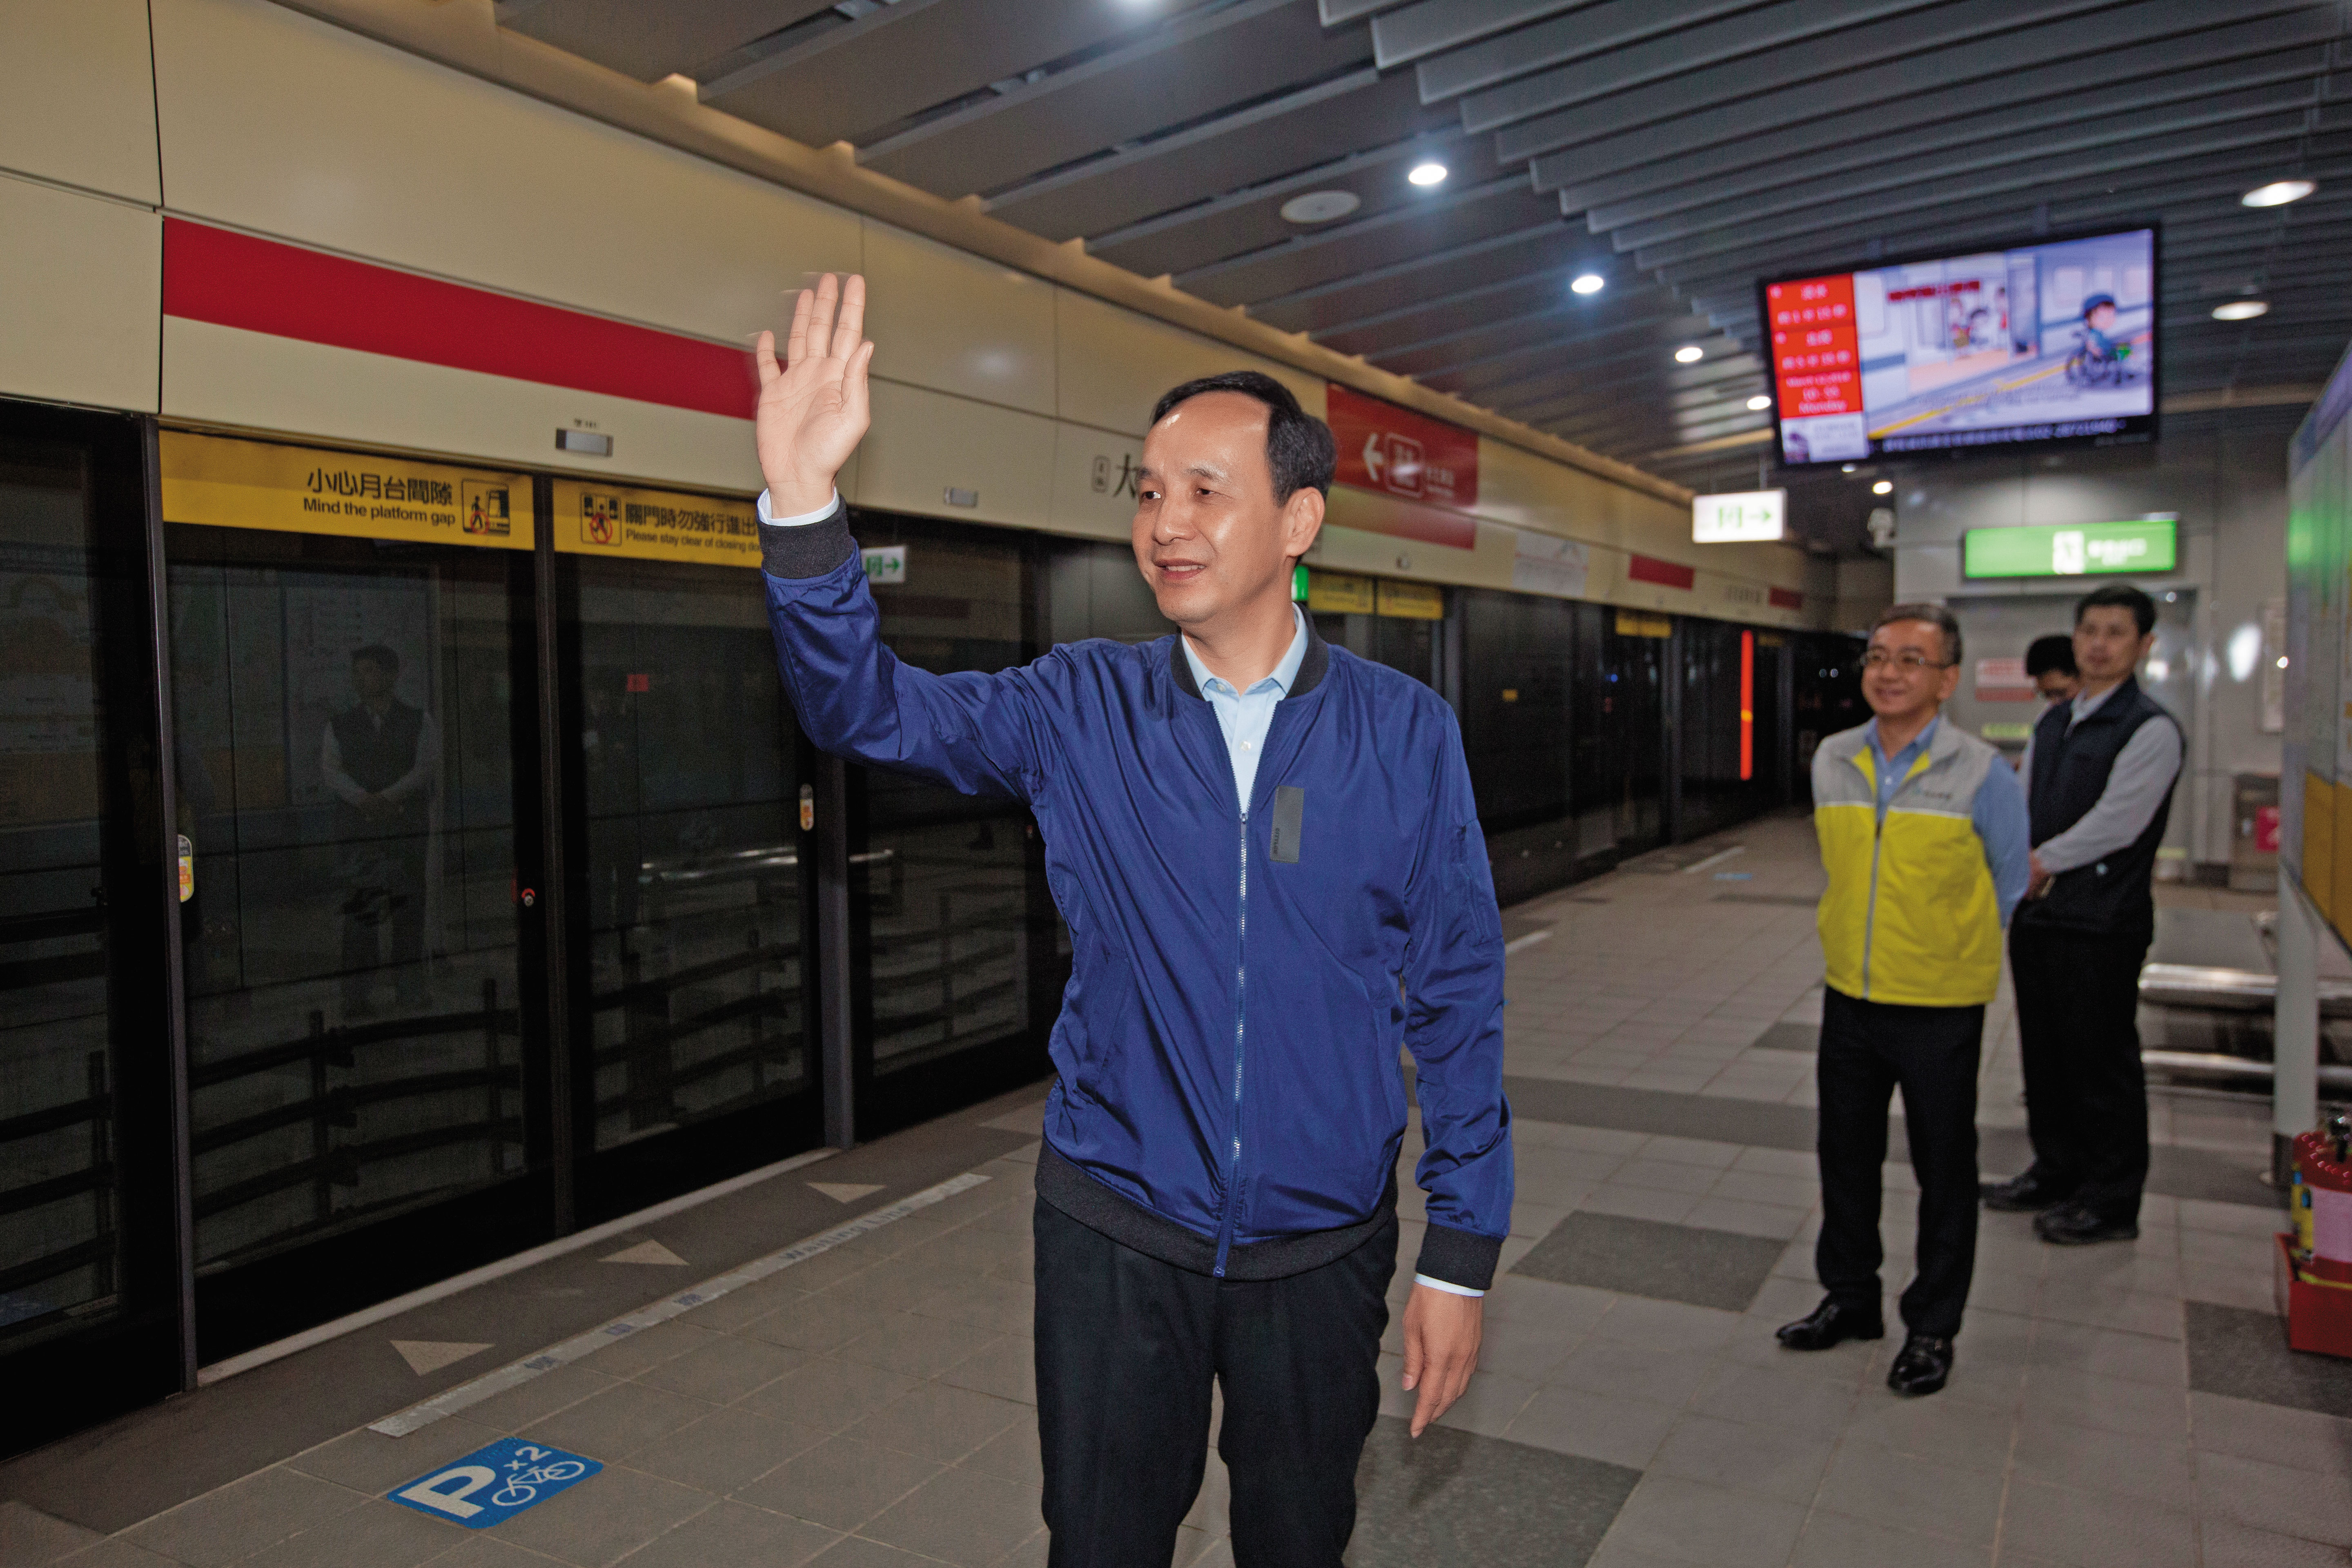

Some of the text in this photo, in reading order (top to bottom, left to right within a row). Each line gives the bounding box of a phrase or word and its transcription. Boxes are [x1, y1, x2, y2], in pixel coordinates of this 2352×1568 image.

[307, 468, 452, 506] 小心月台間隙
[304, 497, 456, 526] Mind the platform gap
[626, 528, 657, 543] Please
[660, 533, 679, 546] stay
[681, 535, 702, 546] clear
[704, 538, 714, 547] of
[715, 539, 746, 553] closing
[397, 1465, 497, 1519] P
